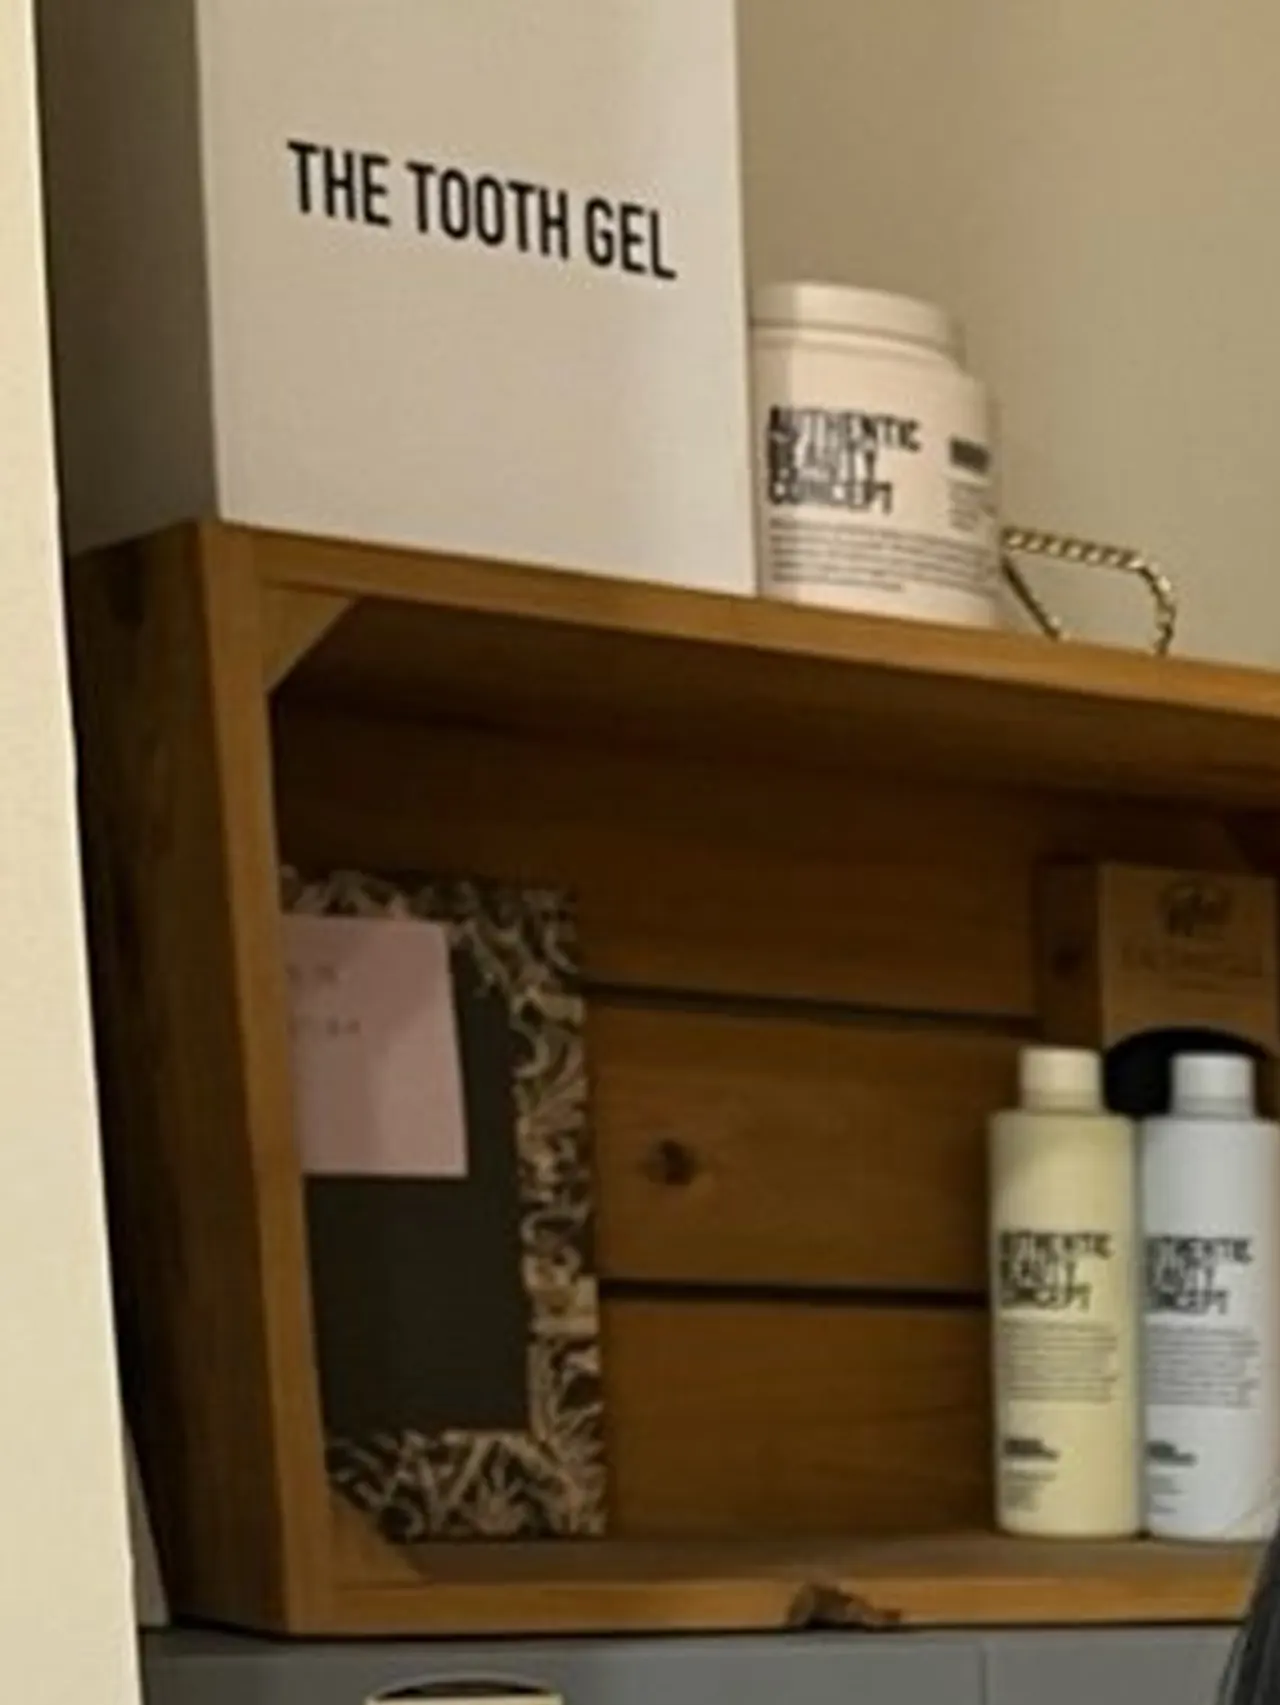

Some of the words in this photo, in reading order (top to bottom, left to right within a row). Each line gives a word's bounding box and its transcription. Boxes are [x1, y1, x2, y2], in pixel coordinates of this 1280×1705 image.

[287, 140, 391, 228] THE
[407, 161, 570, 260] TOOTH
[585, 197, 677, 280] GEL
[767, 405, 922, 452] AUTHENTIC
